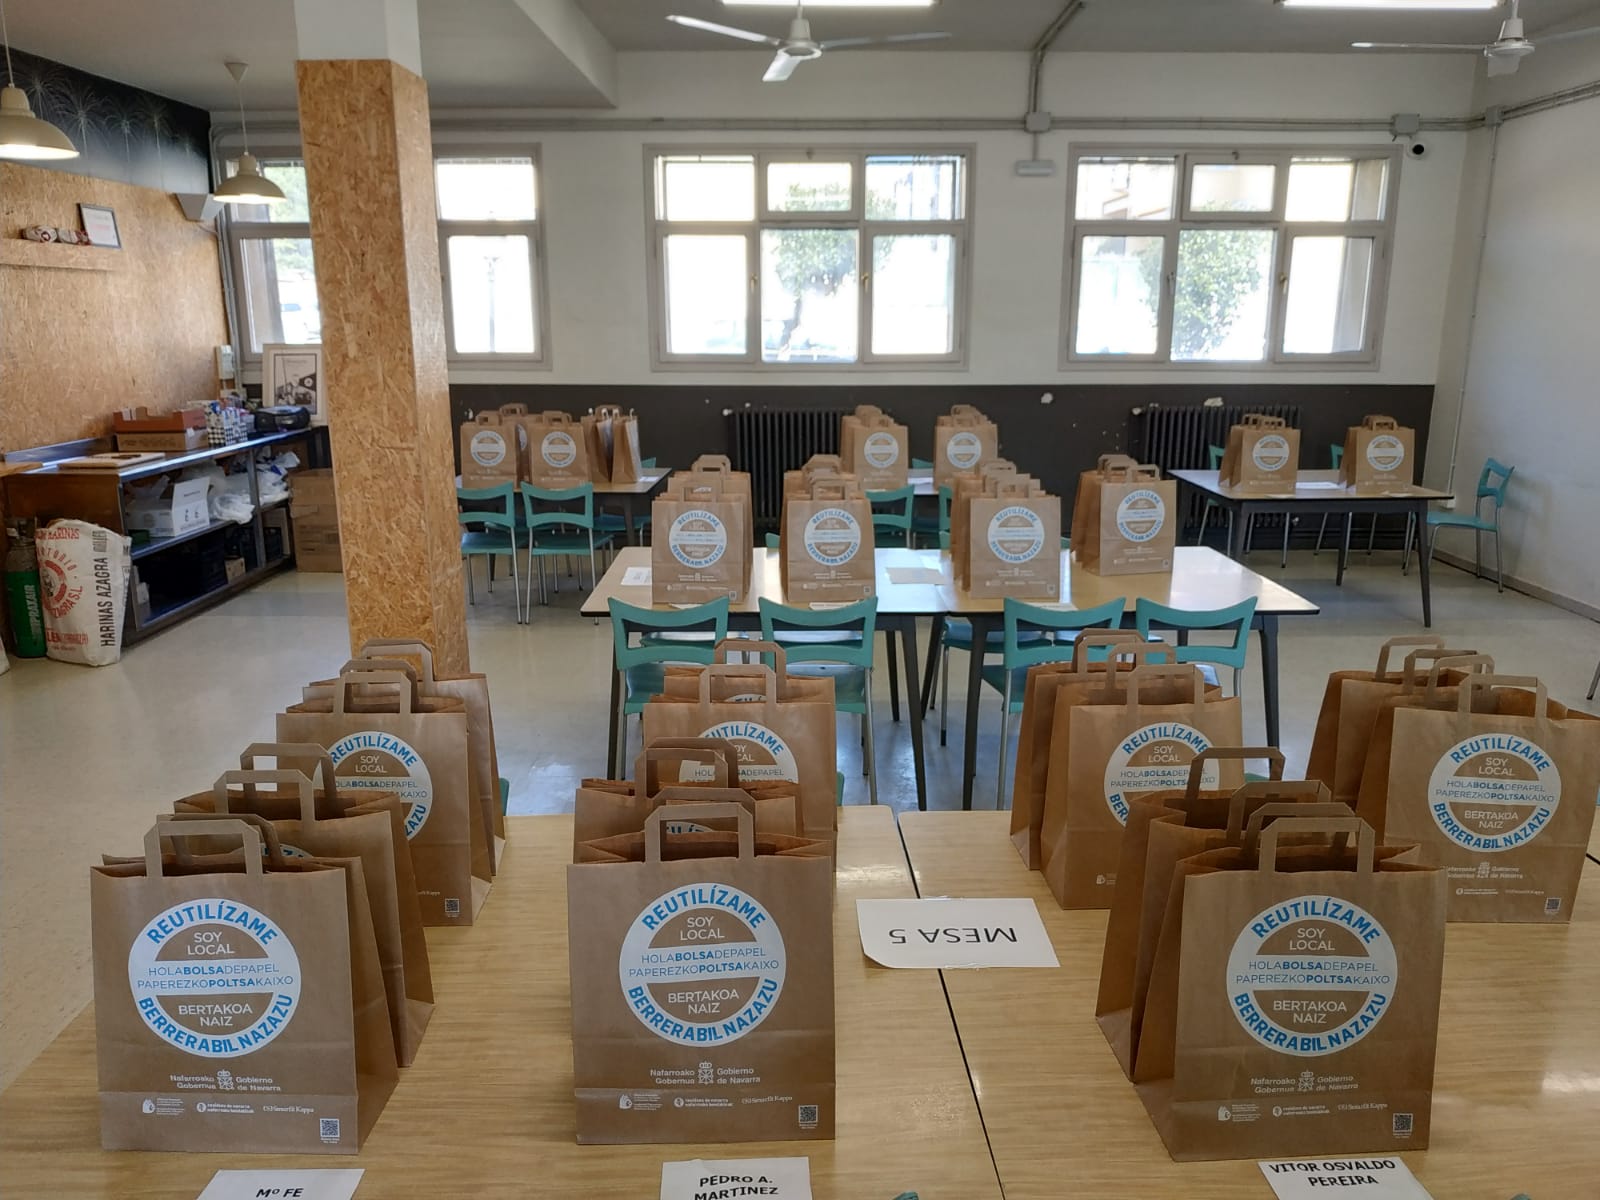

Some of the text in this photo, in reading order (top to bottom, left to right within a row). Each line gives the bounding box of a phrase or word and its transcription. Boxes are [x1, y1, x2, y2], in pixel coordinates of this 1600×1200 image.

[93, 557, 113, 598] AZAGRA
[97, 601, 116, 647] HARINAS
[704, 723, 784, 756] UTILÍZAME
[331, 733, 417, 767] REUTILÍZAME
[1153, 745, 1174, 754] SOY
[1450, 736, 1550, 772] REUTILÍZAME
[360, 755, 380, 764] SOY
[1148, 753, 1181, 763] LOCAL
[1485, 757, 1508, 767] SOY
[355, 764, 388, 774] LOCAL
[1478, 766, 1515, 777] LOCAL
[335, 780, 418, 788] OLABOLSADEPAPEL
[1446, 779, 1546, 792] HOLABOLSADEPAPEL
[1435, 788, 1555, 803] PAPEREZKOPOLTSAKAIXO
[1464, 810, 1519, 821] BERTAKOA
[1433, 802, 1550, 849] BERRERABIL NAZAZU
[1478, 820, 1504, 829] NAIZ
[641, 885, 766, 930] REUTILÍZAME
[147, 901, 278, 945] REUTILÍZAME
[687, 916, 715, 928] SOY
[1251, 898, 1381, 944] REUTILÍZAME
[193, 931, 223, 944] SOY
[679, 928, 725, 941] LOCAL
[888, 927, 1018, 944] MESA 5
[1296, 928, 1327, 940] SOY
[187, 943, 235, 956] LOCAL
[1289, 939, 1336, 952] LOCAL
[641, 947, 766, 965] HOLABOLSADEPAPEL
[148, 963, 280, 977] HOLABOLSADEPAPEL
[629, 959, 780, 978] PAPEREZKOPOLTSAKAIXO
[1248, 959, 1379, 973] HOLABOLSADEPAPEL
[137, 975, 294, 990] PAPEREZKOPOLTSAKAIXO
[1235, 972, 1391, 986] PAPEREZKOPOLTSAKAIXO
[668, 989, 740, 1004] BERTAKOA
[178, 1003, 253, 1016] BERTAKOA
[628, 978, 778, 1042] BERRERABIL NAZAZU
[688, 1003, 721, 1015] NAIZ
[1273, 1000, 1347, 1013] BERTAKOA
[139, 994, 293, 1053] BERRERABIL NAZAZU
[200, 1015, 233, 1027] NAIZ
[1233, 992, 1388, 1052] BERRERABIL NAZAZU
[1292, 1012, 1327, 1024] NAIZ
[650, 1067, 755, 1077] Nafarroako Gobierno
[235, 1076, 273, 1084] Gobierno
[655, 1076, 761, 1085] Gobernua de Navarra
[1250, 1075, 1354, 1086] Nafarroako Gobierno
[1328, 1083, 1359, 1091] Navarra
[1268, 1159, 1397, 1174] VITOR OSVALDO
[699, 1174, 774, 1188] PEDRO A.
[1307, 1175, 1380, 1188] PEREIRA
[283, 1187, 304, 1198] FE
[694, 1186, 779, 1200] MARTINEZ
